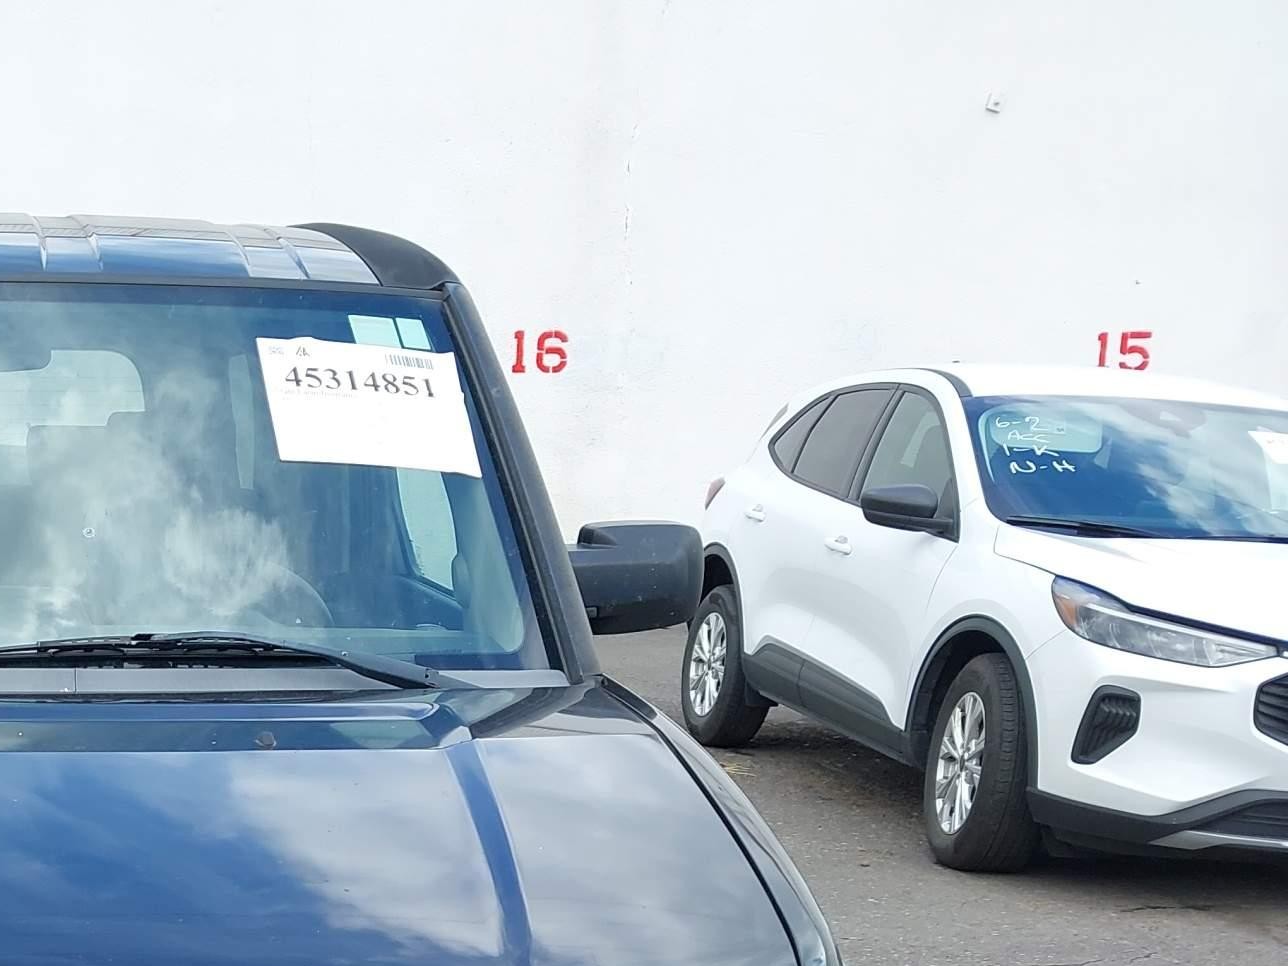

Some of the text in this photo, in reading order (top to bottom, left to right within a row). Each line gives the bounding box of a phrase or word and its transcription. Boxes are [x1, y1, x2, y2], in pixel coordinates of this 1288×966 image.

[512, 330, 569, 373] 16
[1098, 332, 1152, 370] 15
[285, 366, 435, 398] 45314851
